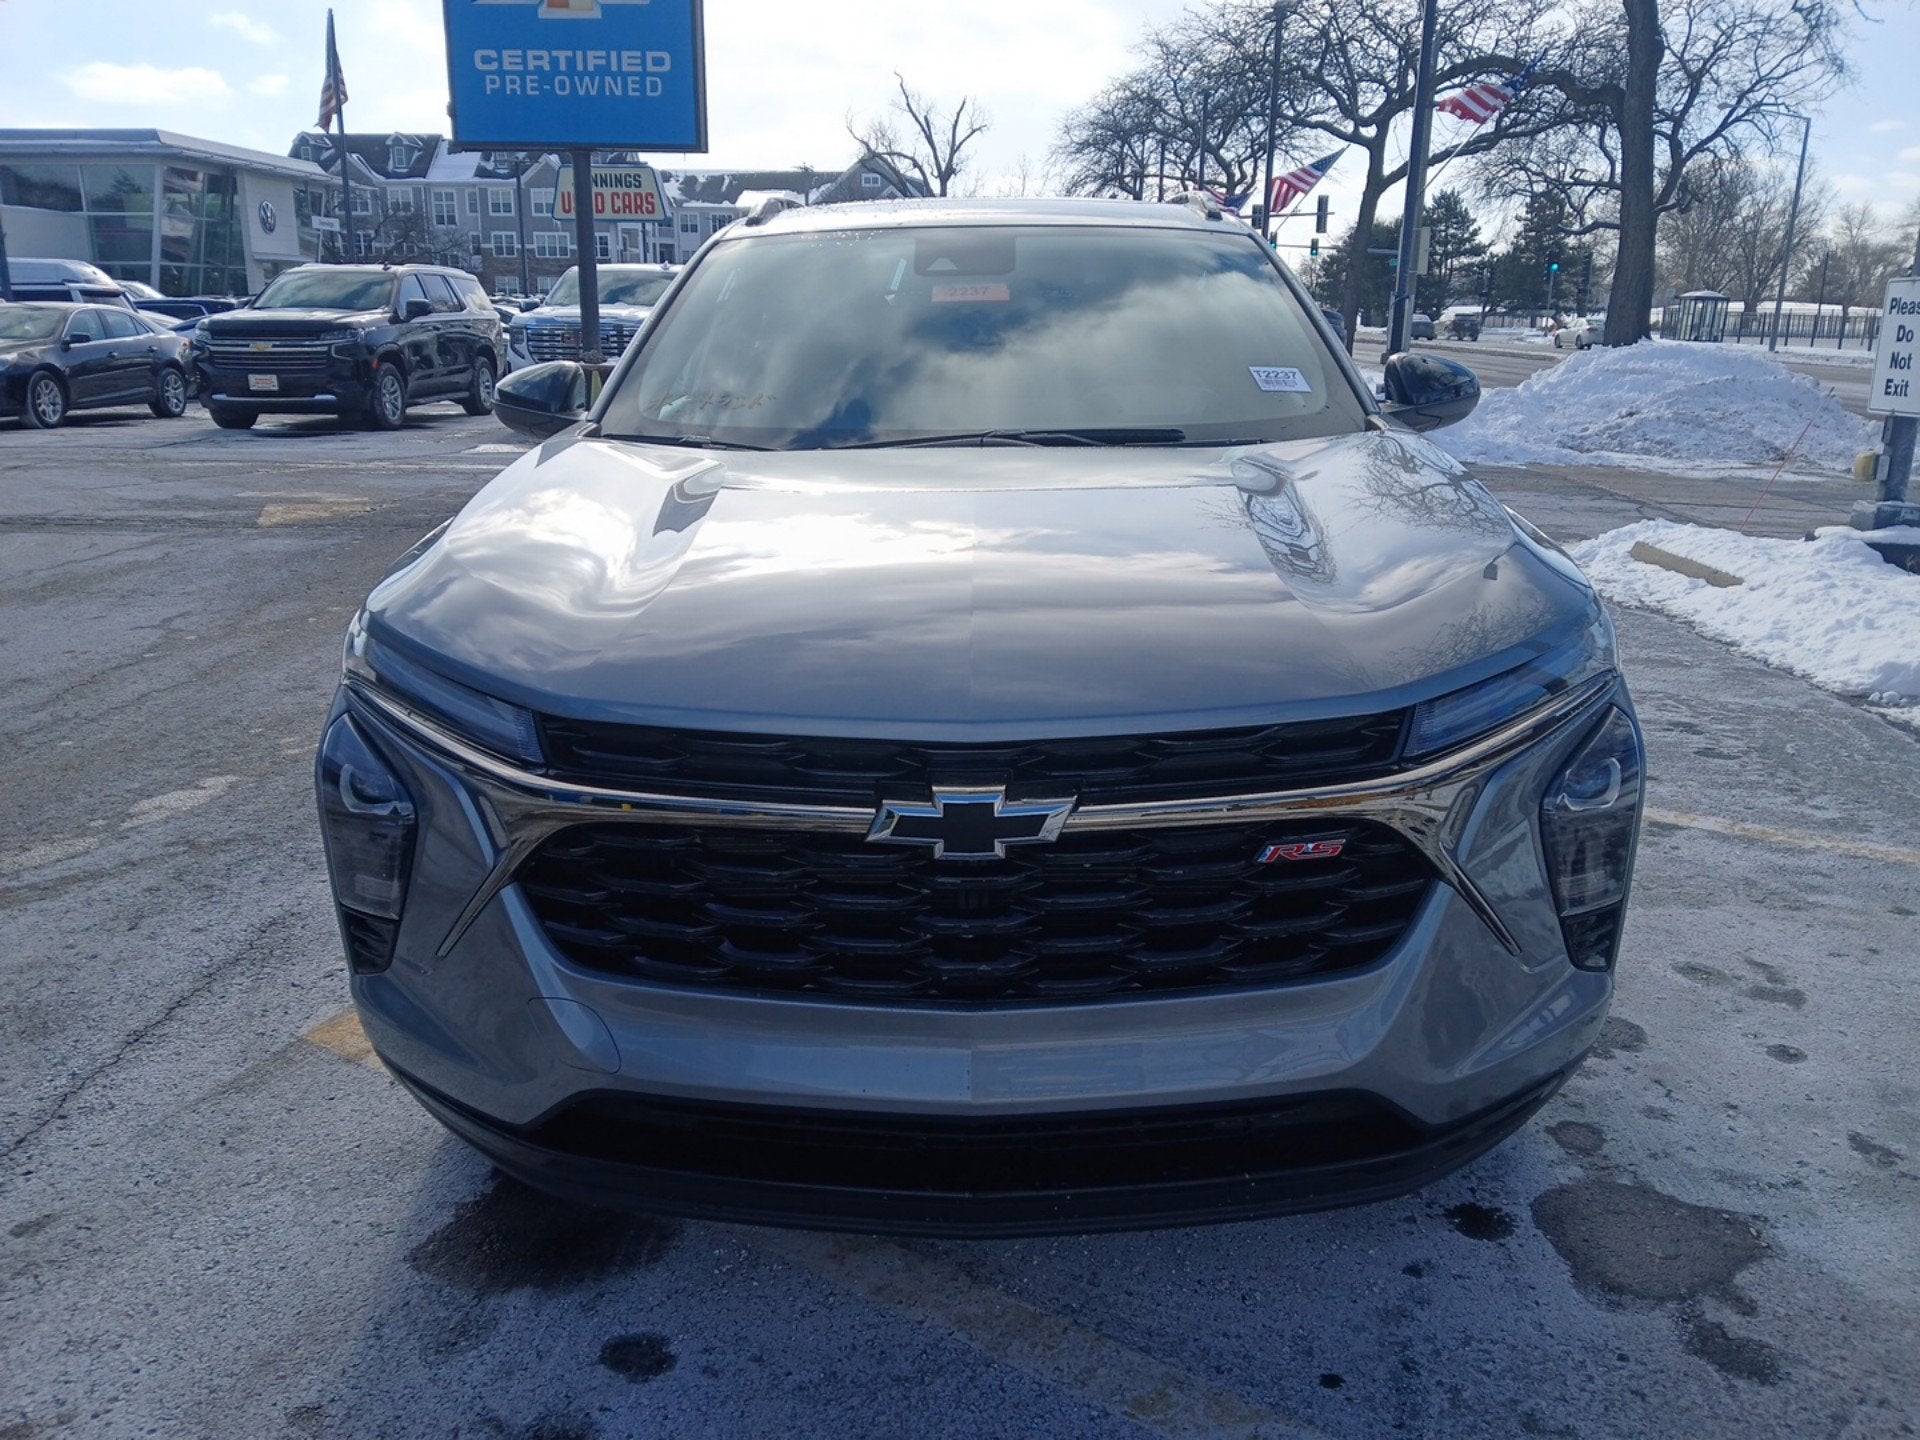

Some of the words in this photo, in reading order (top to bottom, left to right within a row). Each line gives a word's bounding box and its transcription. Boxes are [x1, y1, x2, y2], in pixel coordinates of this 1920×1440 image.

[474, 49, 671, 72] CERTIFIED
[485, 75, 662, 96] PRE-OWNED
[572, 173, 642, 188] NNINGS
[561, 192, 605, 214] UD
[611, 192, 655, 214] CARS
[1896, 325, 1914, 342] Do
[1889, 352, 1912, 370] Not
[1252, 370, 1297, 380] T2237
[1884, 379, 1909, 397] Exit
[1258, 839, 1346, 862] RS
